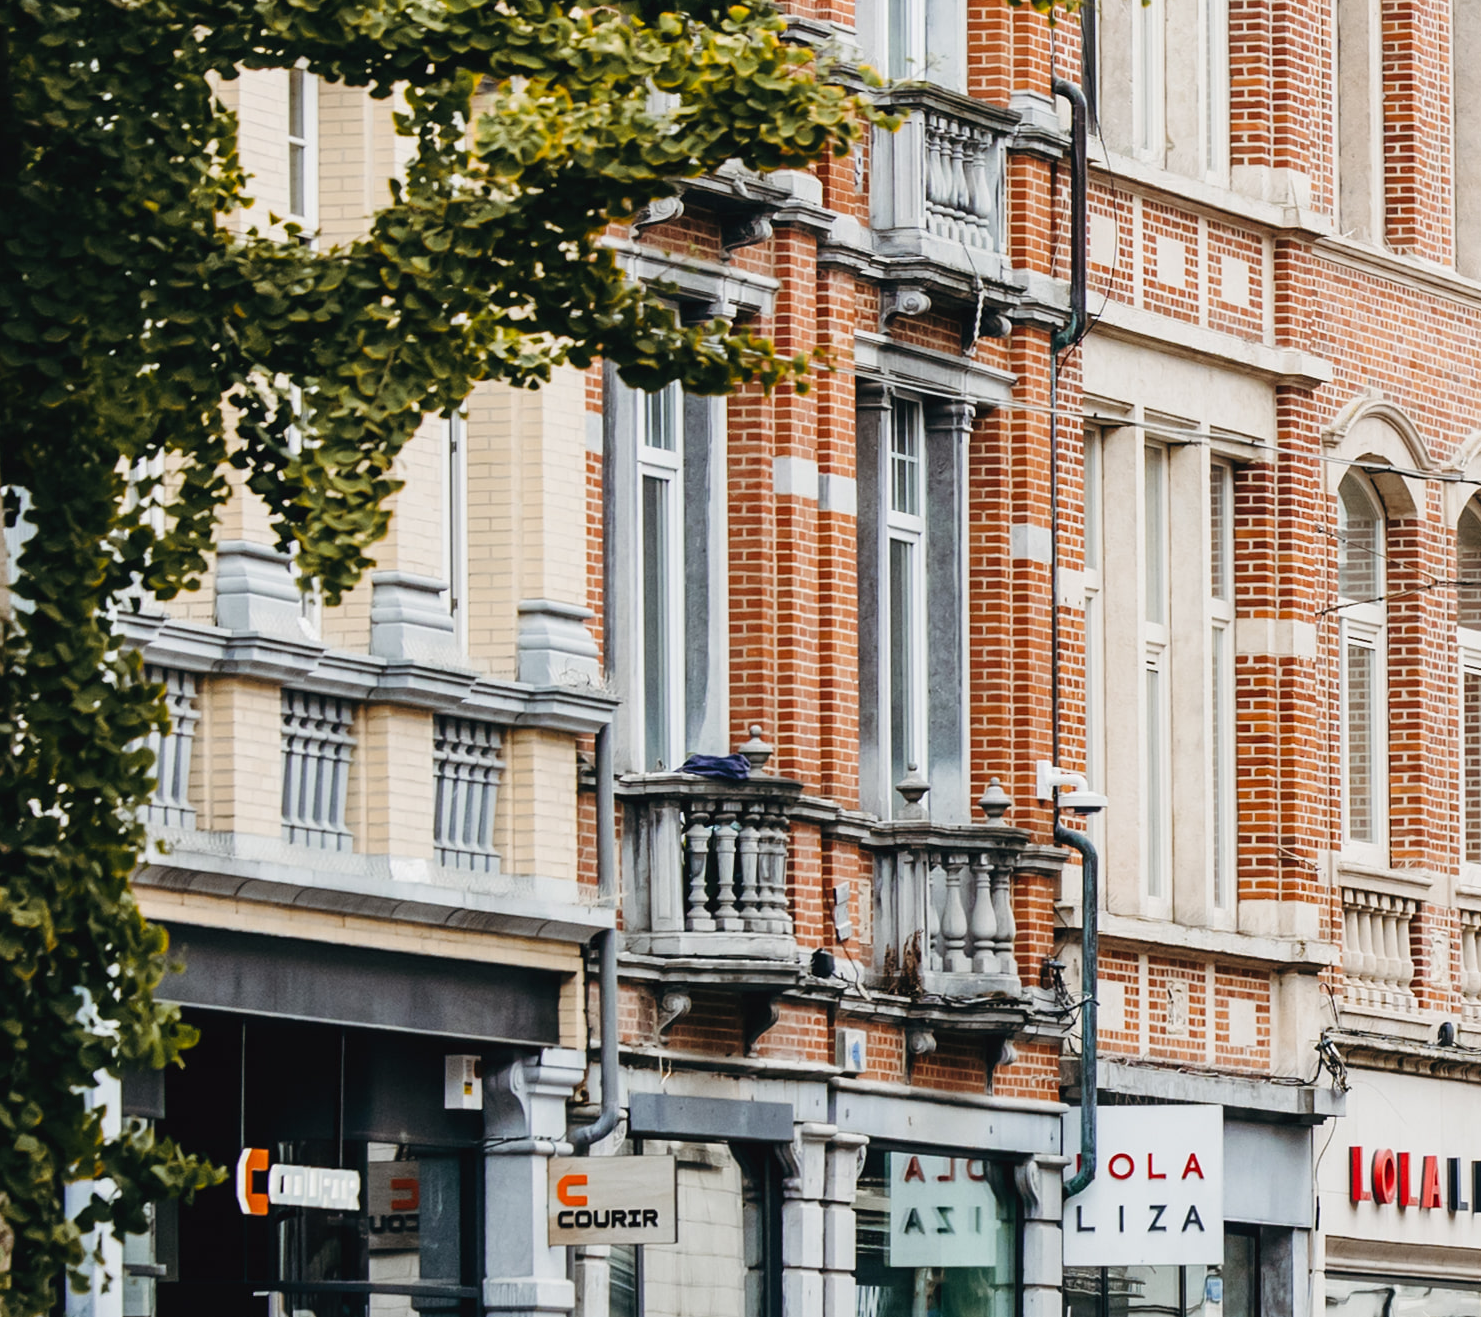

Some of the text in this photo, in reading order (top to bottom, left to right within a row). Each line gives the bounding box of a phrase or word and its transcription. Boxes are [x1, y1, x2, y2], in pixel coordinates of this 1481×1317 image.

[1076, 1153, 1205, 1180] OLA
[557, 1209, 659, 1229] COURIR
[1076, 1205, 1205, 1233] LIZA
